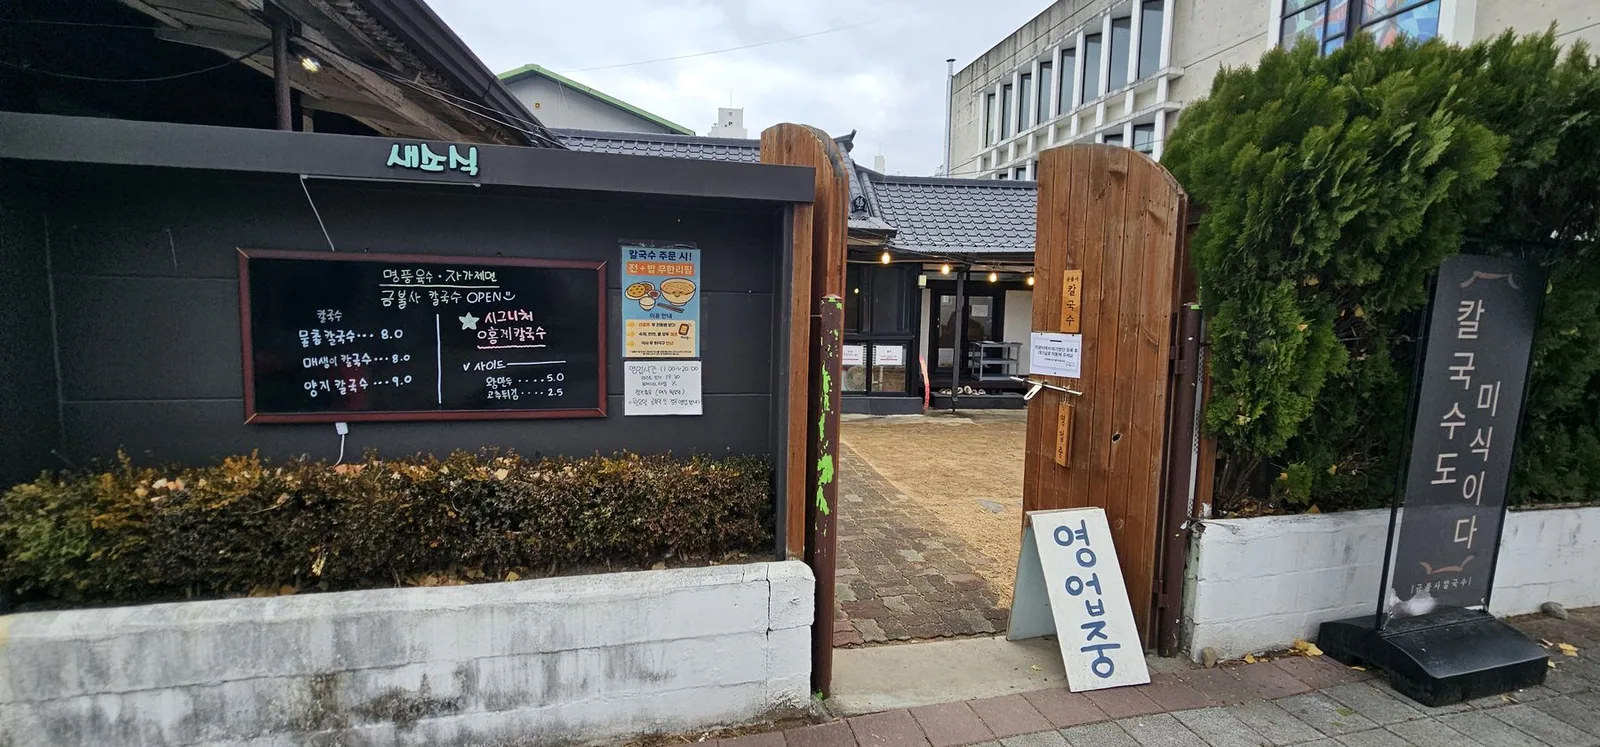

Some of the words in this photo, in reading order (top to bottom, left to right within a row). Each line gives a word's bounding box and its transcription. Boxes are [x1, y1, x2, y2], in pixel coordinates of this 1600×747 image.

[386, 143, 479, 176] 새소식
[629, 249, 657, 260] 칼국수
[659, 251, 677, 261] 주문
[679, 252, 692, 261] 시!
[445, 268, 497, 283] 자가제면
[628, 263, 638, 273] 전
[647, 264, 656, 274] 밥
[658, 266, 693, 275] 무한리필
[428, 290, 463, 306] 칼국수
[466, 291, 501, 304] OPEN
[1065, 283, 1077, 327] 칼국수
[317, 309, 343, 324] 칼국수
[484, 309, 534, 325] 시그니처
[324, 329, 355, 346] 칼국수
[380, 329, 404, 340] 8.0
[303, 356, 338, 369] 매생이
[340, 353, 372, 368] 칼국수
[392, 354, 410, 363] 8.0
[473, 360, 507, 371] 사이드
[629, 366, 657, 374] 영업시간
[304, 380, 331, 397] 양지
[334, 378, 369, 395] 칼국수
[392, 375, 412, 387] 9.0
[486, 376, 513, 389] 왕만두
[546, 373, 565, 382] 5.0
[487, 388, 519, 400] 고추튀김
[547, 388, 564, 397] 2.5
[1431, 299, 1485, 485] 칼국수도
[1453, 381, 1501, 549] 미식이다
[1053, 519, 1121, 678] 영업중
